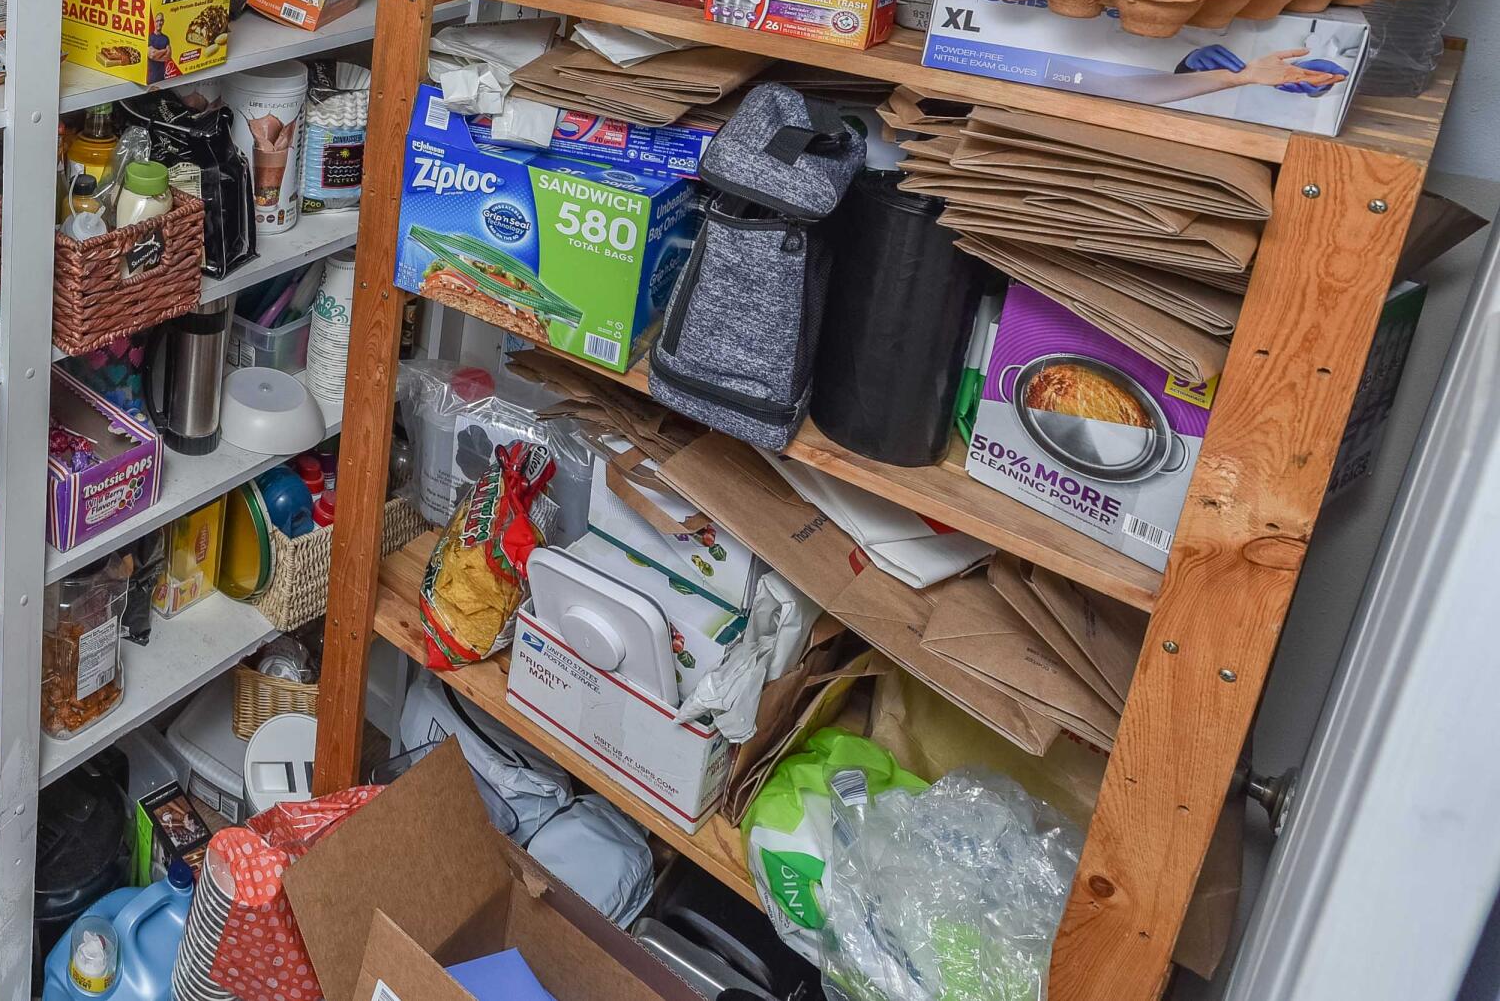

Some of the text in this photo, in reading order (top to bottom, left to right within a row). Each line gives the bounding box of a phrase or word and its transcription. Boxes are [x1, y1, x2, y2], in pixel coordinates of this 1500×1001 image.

[111, 13, 146, 38] BAR
[765, 20, 779, 31] 26
[941, 6, 981, 33] XL
[933, 53, 1037, 77] NITRILE EXAM GLOVES
[935, 44, 1005, 62] POWDER-FREE
[1052, 73, 1071, 83] 230
[412, 157, 498, 195] Ziploc
[538, 174, 642, 215] SANDWICH
[486, 218, 525, 235] Technology
[554, 201, 638, 252] 580
[567, 237, 634, 263] TOTAL BAGS
[527, 445, 549, 477] Gluten
[83, 455, 153, 498] Tootsie POPS
[969, 450, 1111, 526] CLEANING POWER
[970, 434, 1122, 518] 50% MORE
[793, 526, 814, 544] Thank
[519, 651, 568, 690] PRIORITY
[543, 651, 569, 673] POSTAL
[546, 644, 599, 683] UNITED STATES
[528, 667, 555, 690] MAIL
[593, 733, 634, 764] VISIT US AT
